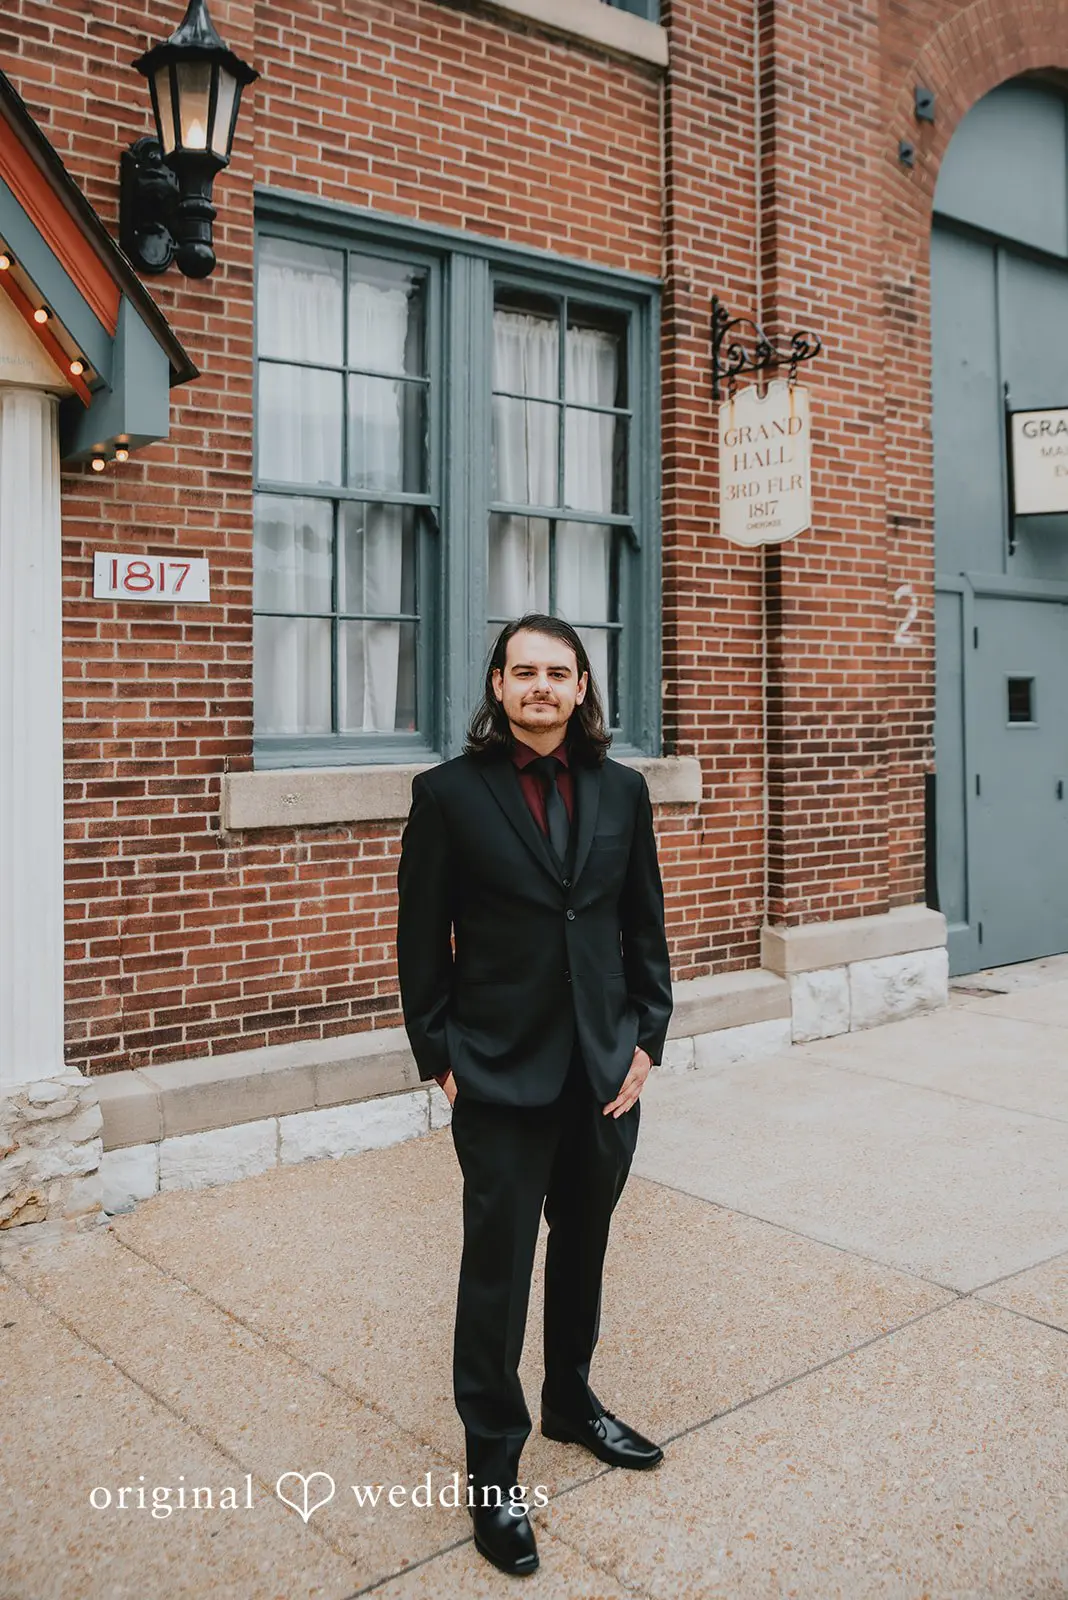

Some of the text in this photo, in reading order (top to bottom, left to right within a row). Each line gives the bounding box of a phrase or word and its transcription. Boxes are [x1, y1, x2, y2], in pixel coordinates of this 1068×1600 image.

[723, 416, 803, 447] GRAND
[733, 446, 794, 472] HALL
[725, 475, 803, 501] 3RD FLR
[749, 499, 779, 518] 1817
[109, 558, 191, 595] 1817
[893, 583, 922, 645] 2
